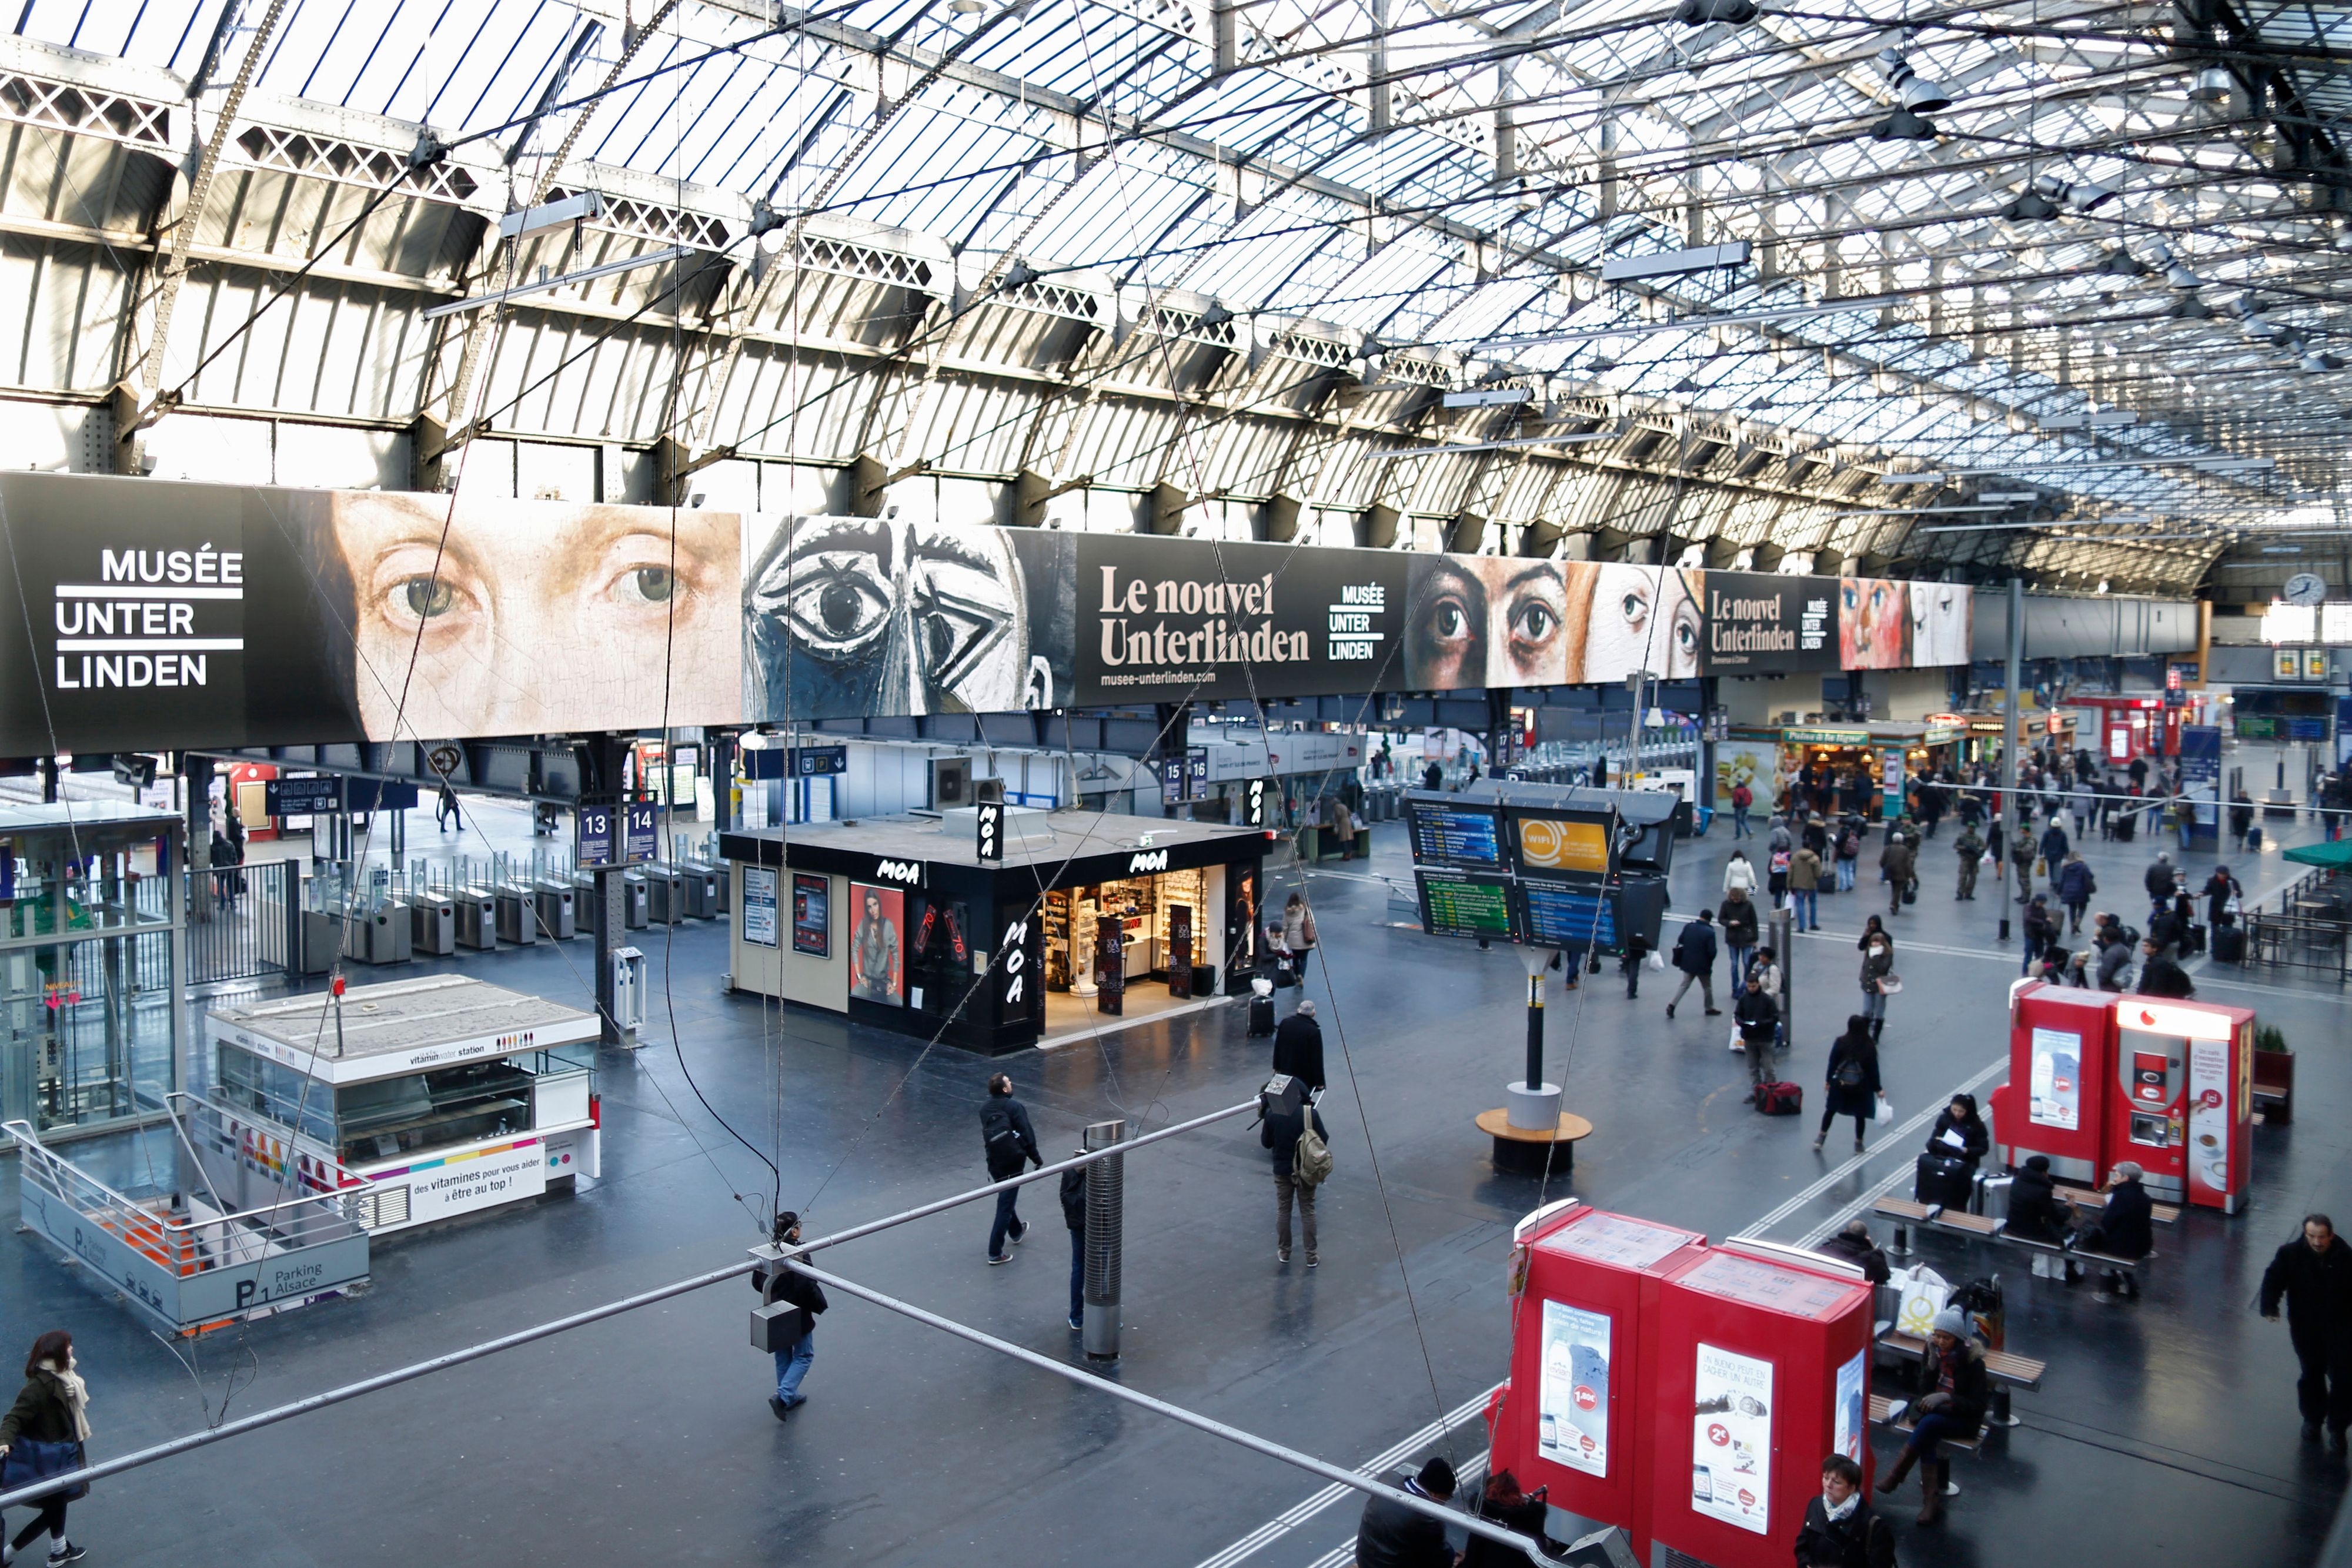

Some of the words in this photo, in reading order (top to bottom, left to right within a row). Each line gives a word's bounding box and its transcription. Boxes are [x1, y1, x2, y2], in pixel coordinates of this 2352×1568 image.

[102, 542, 243, 584] MUSÉE
[1100, 566, 1147, 615] Le
[1154, 572, 1274, 616] nouvel
[1342, 581, 1385, 606] MUSÉE
[1712, 590, 1731, 620] Le
[1732, 592, 1781, 621] nouvel
[55, 601, 194, 635] UNTER
[1329, 614, 1369, 633] UNTER
[1100, 618, 1309, 667] Unterlinden
[1711, 622, 1795, 653] Unterlinden
[1328, 641, 1374, 661] LINDEN
[56, 655, 206, 689] LINDEN
[1101, 672, 1216, 686] musee-unterlinden.com
[1499, 734, 1507, 746] 17
[1515, 733, 1524, 745] 18
[1168, 764, 1180, 779] 15
[1194, 762, 1205, 777] 16
[1250, 780, 1264, 823] MOA
[586, 815, 606, 834] 13
[633, 810, 652, 830] 14
[979, 805, 997, 857] MOA
[1528, 835, 1551, 844] WIFI
[876, 859, 920, 885] MOA
[1129, 849, 1168, 874] MOA
[923, 912, 934, 930] 70
[952, 935, 963, 953] 70
[1003, 921, 1028, 1004] MOA
[410, 1050, 456, 1065] vitaminwater
[458, 1045, 485, 1057] station
[2207, 1092, 2217, 1104] ici
[415, 1183, 429, 1194] des
[431, 1171, 480, 1191] vitamines
[482, 1167, 500, 1181] pour
[502, 1163, 519, 1174] vous
[522, 1158, 540, 1169] aider
[445, 1192, 450, 1202] à
[452, 1185, 472, 1201] être
[475, 1184, 487, 1195] au
[490, 1179, 506, 1192] top
[75, 1228, 82, 1252] P
[276, 1264, 322, 1283] Parking
[236, 1279, 256, 1308] P
[260, 1287, 269, 1302] 1
[275, 1277, 316, 1295] Alsace
[1549, 1366, 1571, 1376] evian
[1703, 1364, 1728, 1379] CACHER
[1731, 1373, 1740, 1382] UN
[1745, 1376, 1764, 1389] AUTRE
[1705, 1355, 1712, 1364] UN
[1715, 1357, 1735, 1370] BUENO
[1738, 1365, 1753, 1375] PEUT
[1756, 1370, 1765, 1379] EN
[1712, 1428, 1726, 1442] 2€
